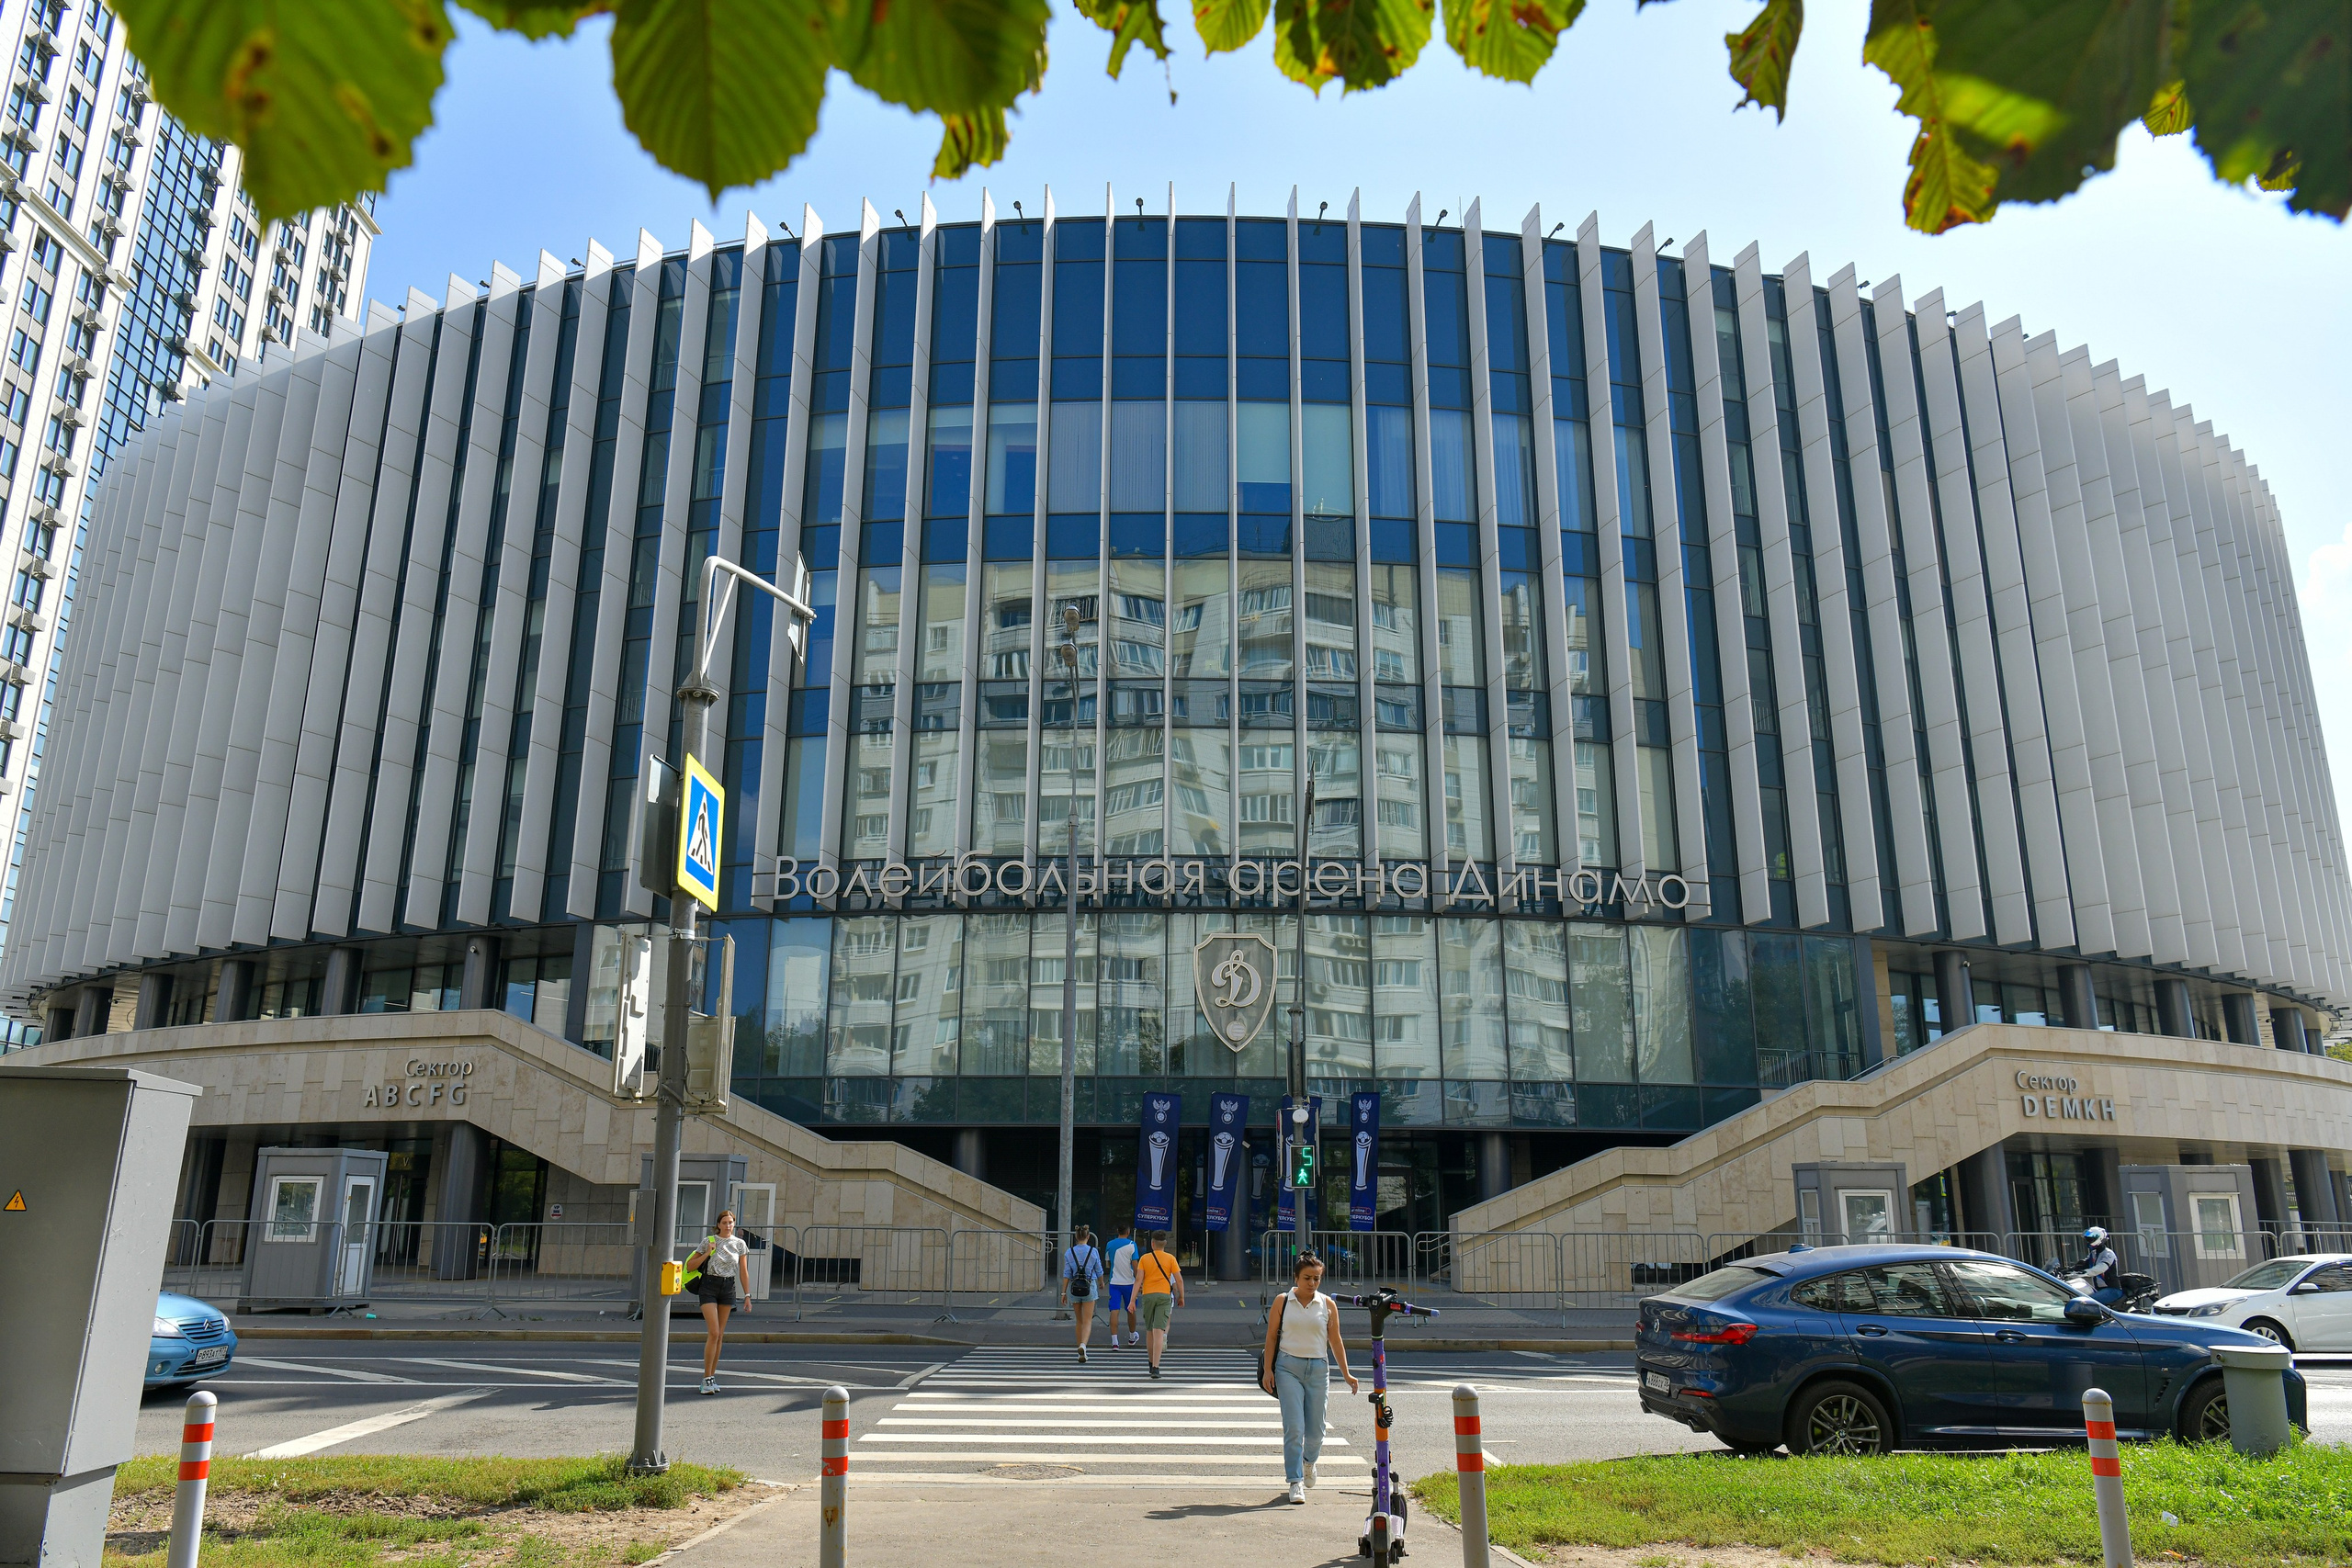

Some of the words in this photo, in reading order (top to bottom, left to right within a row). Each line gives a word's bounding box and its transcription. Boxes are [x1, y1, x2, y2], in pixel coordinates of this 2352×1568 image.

[774, 849, 1204, 900] Волейбольная
[1228, 860, 1428, 908] арена
[1449, 855, 1690, 908] Динамо
[404, 1058, 473, 1079] Сектор
[2016, 1070, 2078, 1095] Сектор
[1302, 1147, 1312, 1166] 5
[1136, 1213, 1170, 1222] СУПЕРКУБОК
